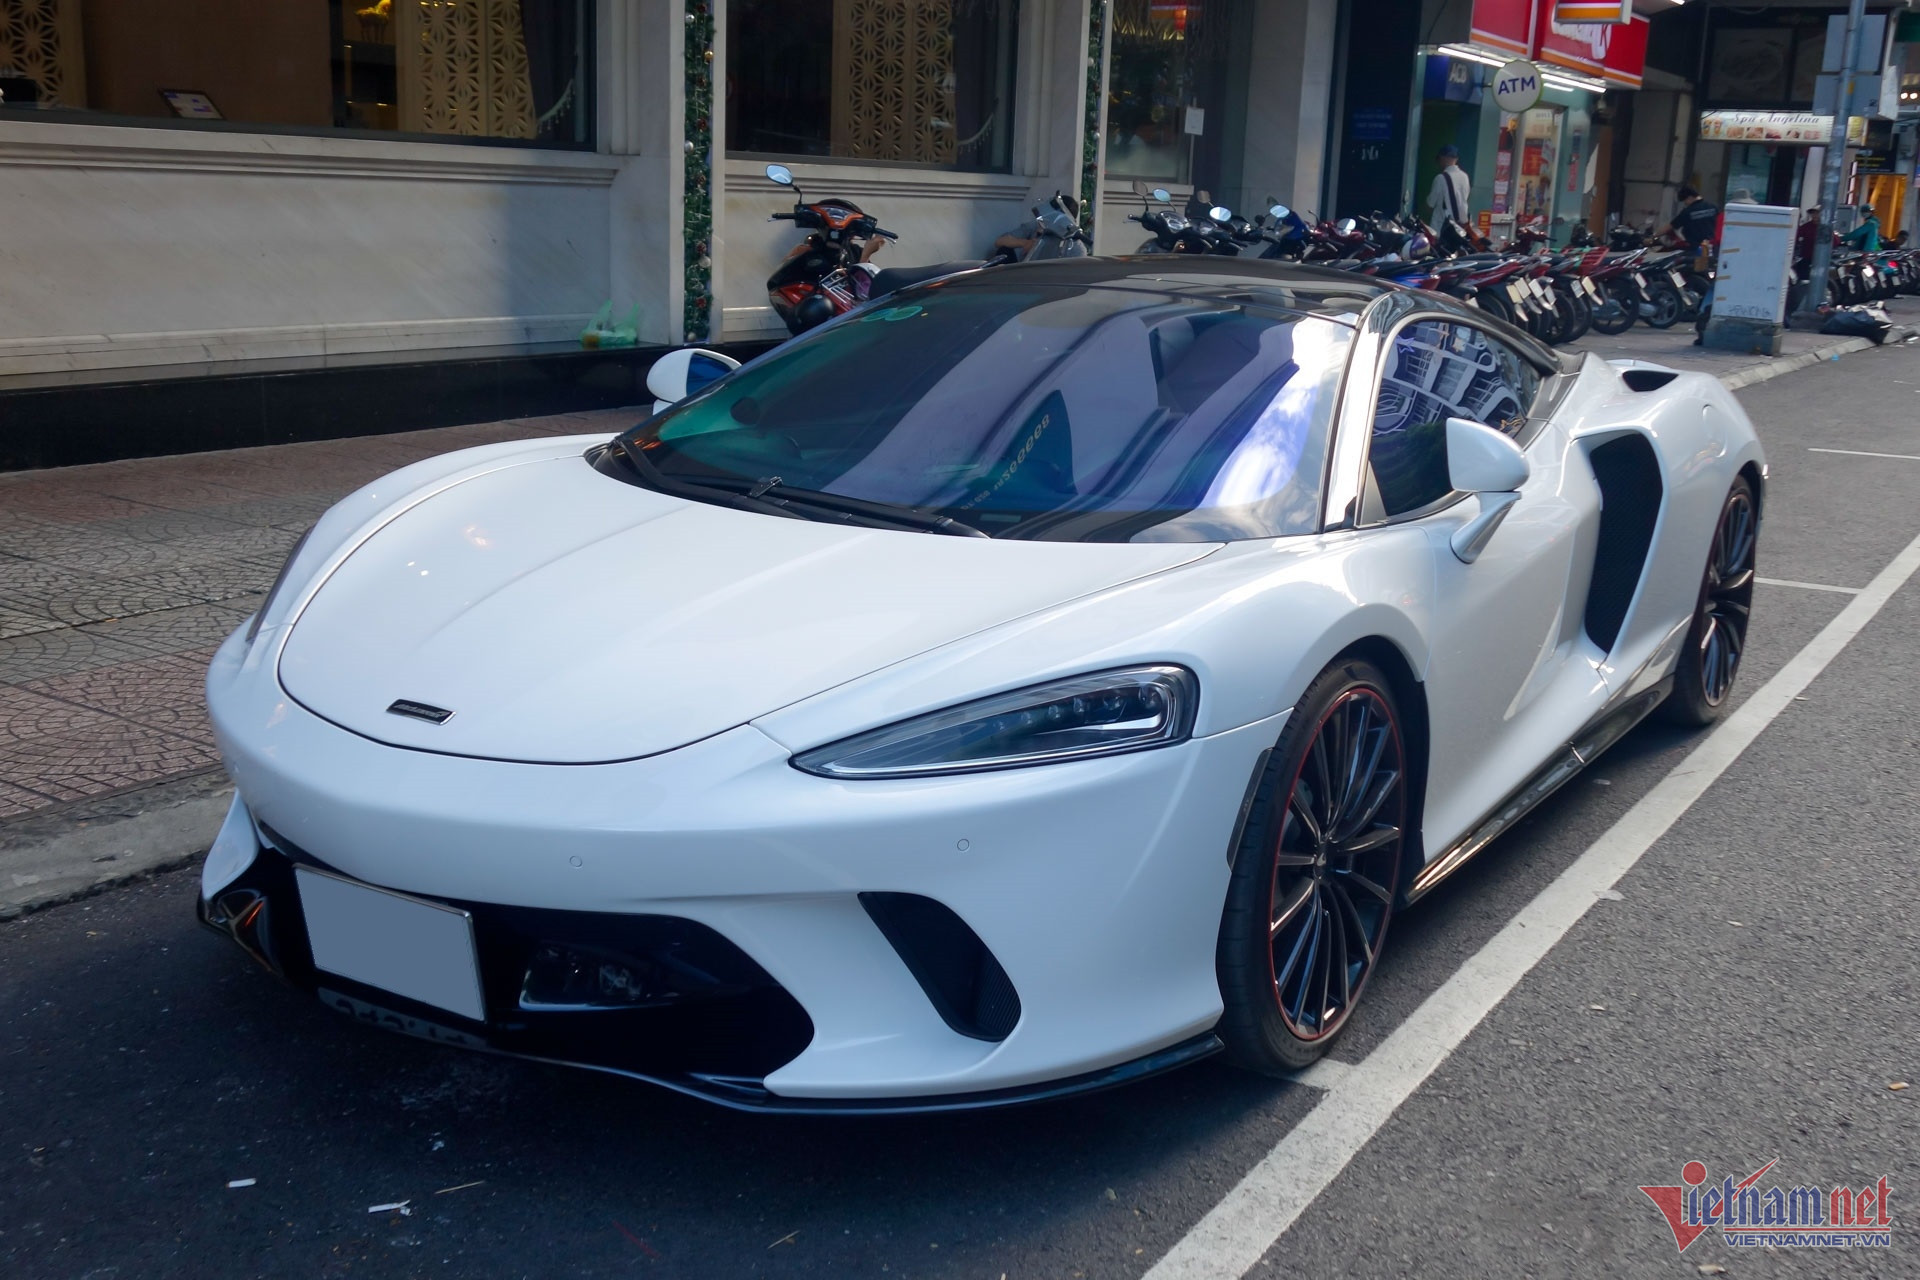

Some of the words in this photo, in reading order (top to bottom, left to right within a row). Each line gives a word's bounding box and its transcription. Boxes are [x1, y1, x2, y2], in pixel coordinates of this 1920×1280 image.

[1498, 75, 1536, 96] ATM
[1735, 111, 1756, 125] Spa
[1760, 111, 1820, 125] Angelina
